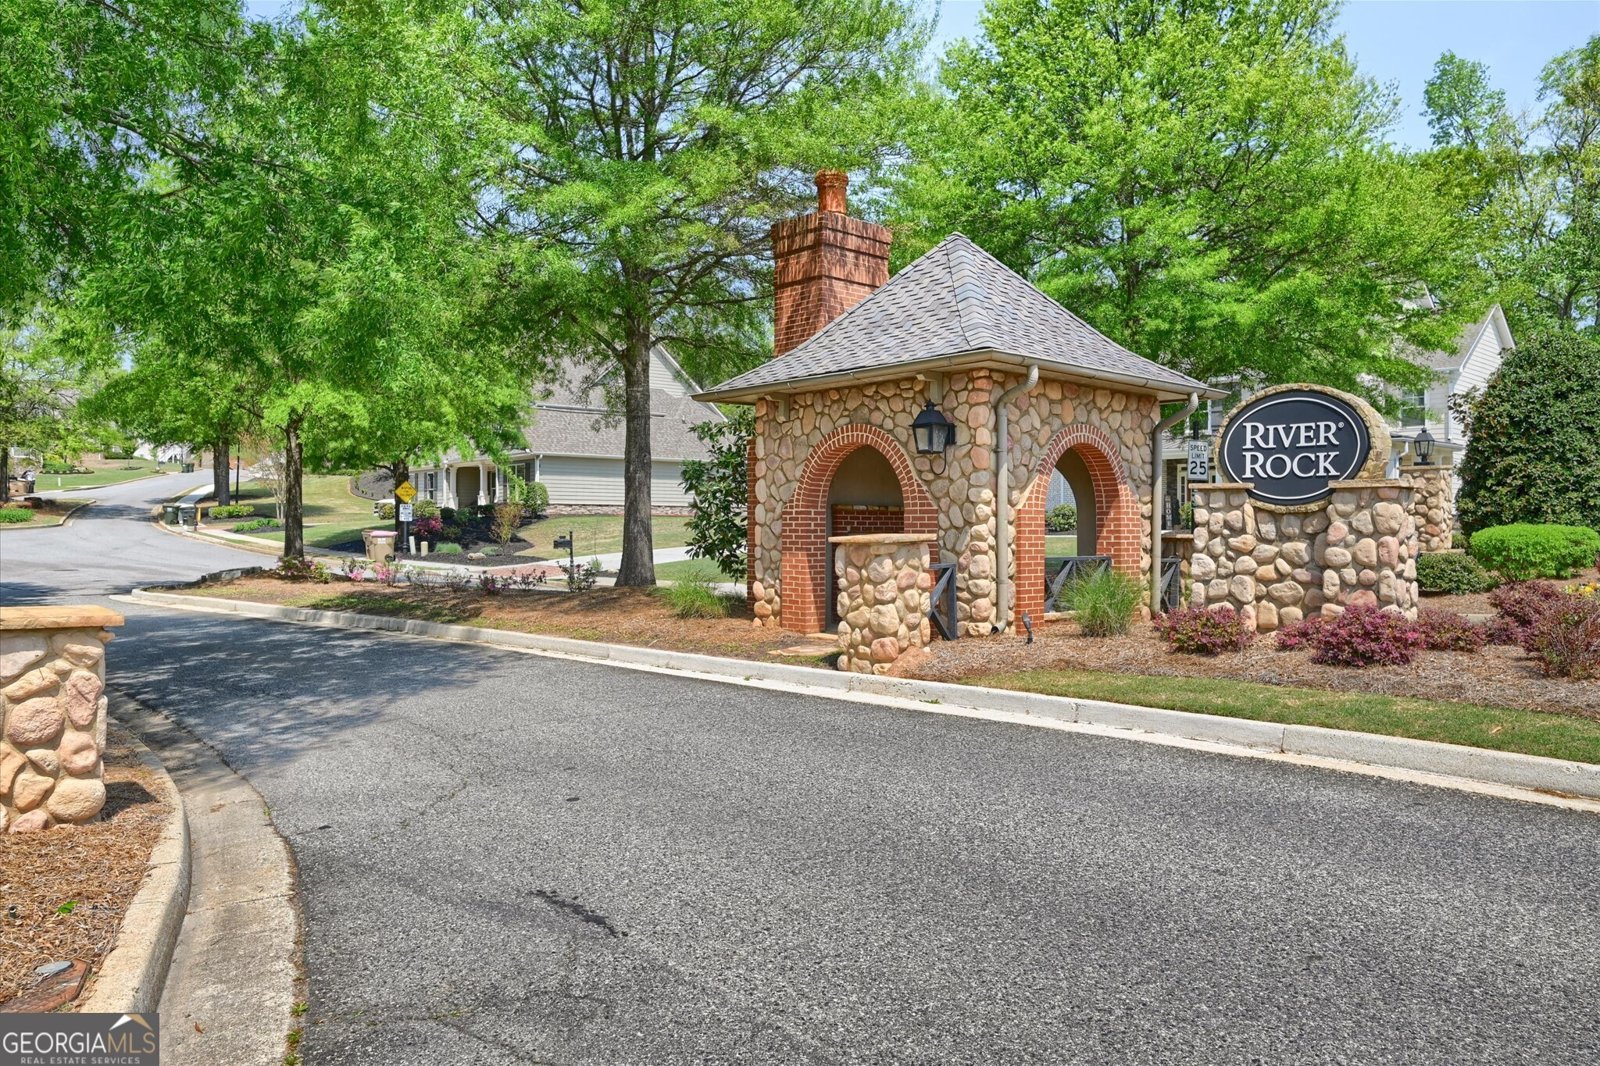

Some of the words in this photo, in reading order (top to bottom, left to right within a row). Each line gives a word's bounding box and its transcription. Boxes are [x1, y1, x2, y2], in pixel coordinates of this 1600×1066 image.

[1190, 444, 1207, 452] SPEED
[1190, 460, 1207, 475] 25
[1242, 451, 1340, 479] ROCK
